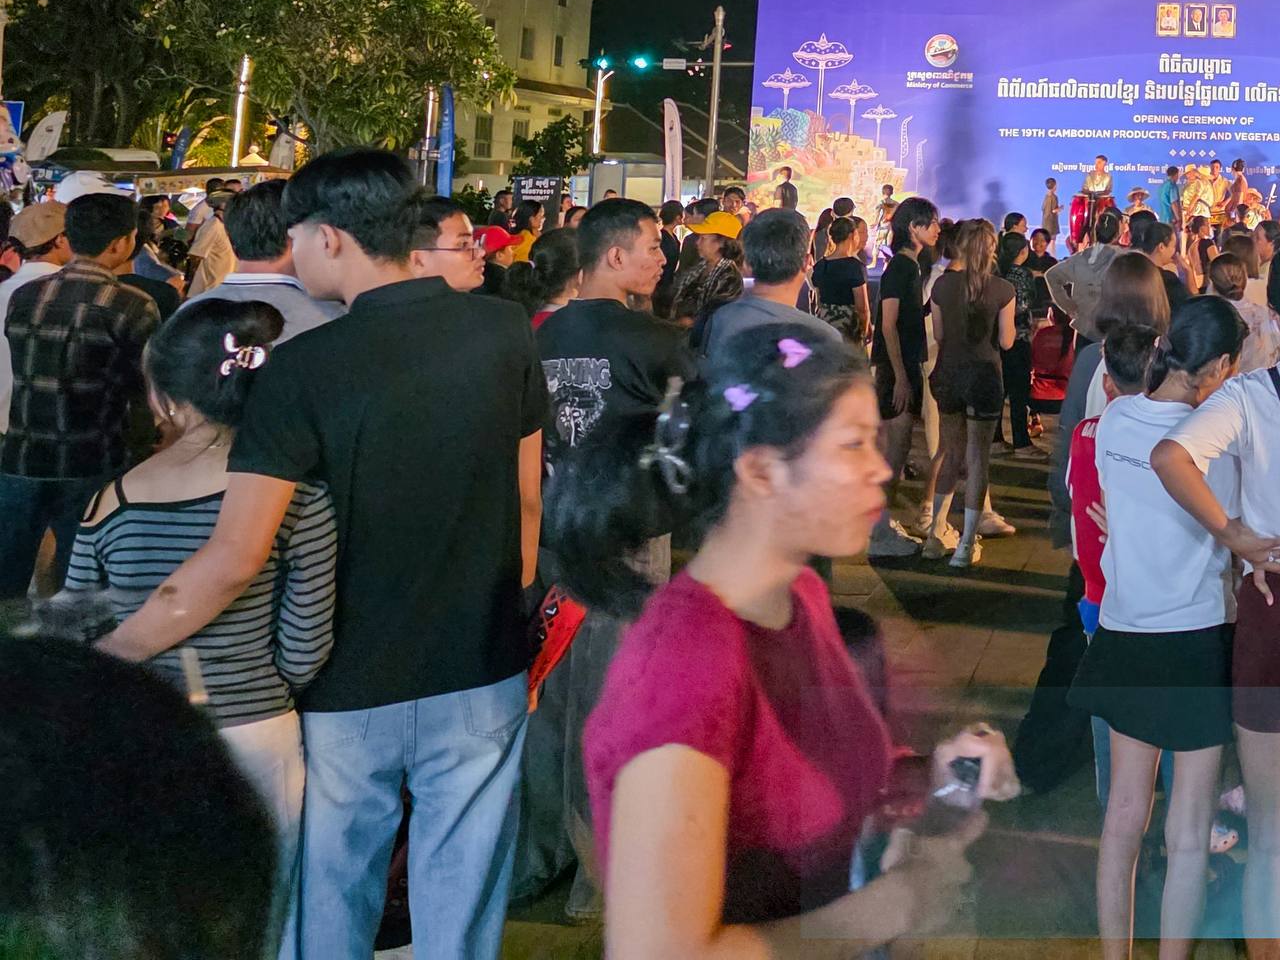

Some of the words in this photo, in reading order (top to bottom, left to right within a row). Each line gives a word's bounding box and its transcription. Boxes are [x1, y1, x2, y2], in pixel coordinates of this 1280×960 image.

[1133, 114, 1179, 124] OPENING
[1181, 116, 1237, 125] CEREMONY
[1240, 117, 1254, 125] OF
[998, 128, 1019, 137] THE
[1021, 128, 1045, 138] 19TH
[1048, 129, 1111, 139] CAMBODIAN
[1113, 130, 1170, 140] PRODUCTS,
[1172, 131, 1207, 140] FRUITS
[1209, 132, 1232, 141] AND
[1105, 450, 1151, 470] PORSC
